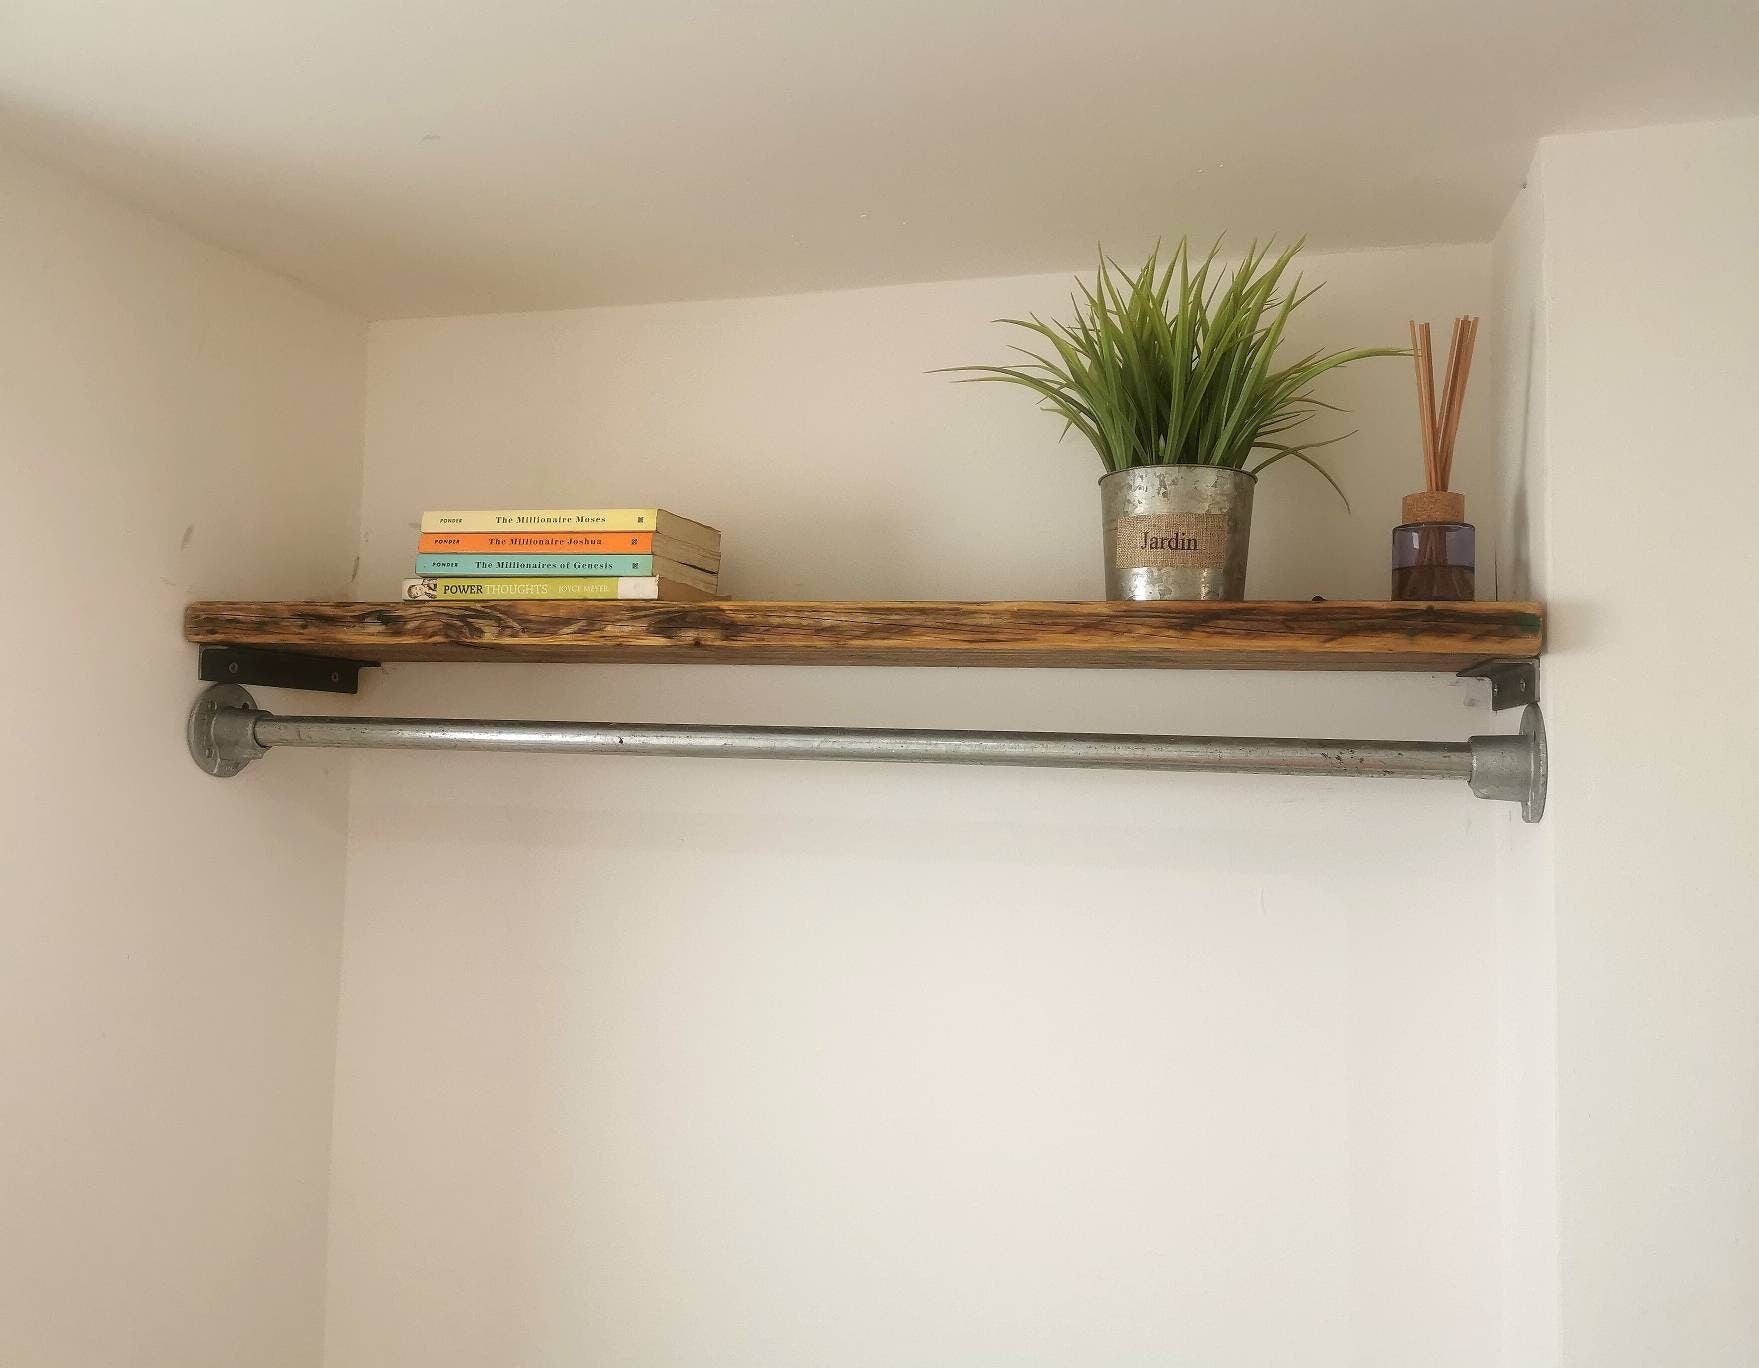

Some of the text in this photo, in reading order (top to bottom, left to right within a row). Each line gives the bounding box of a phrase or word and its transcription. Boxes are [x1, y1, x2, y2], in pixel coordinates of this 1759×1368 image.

[439, 517, 464, 525] PONDER
[495, 515, 606, 525] The Millionaire Moses
[489, 537, 602, 546] The Millionaire Joshua
[1140, 531, 1199, 551] Jardin
[475, 561, 613, 569] The Millionaires of Genesis
[443, 584, 549, 595] POWER THOUGHTS
[583, 584, 609, 593] MEYER
